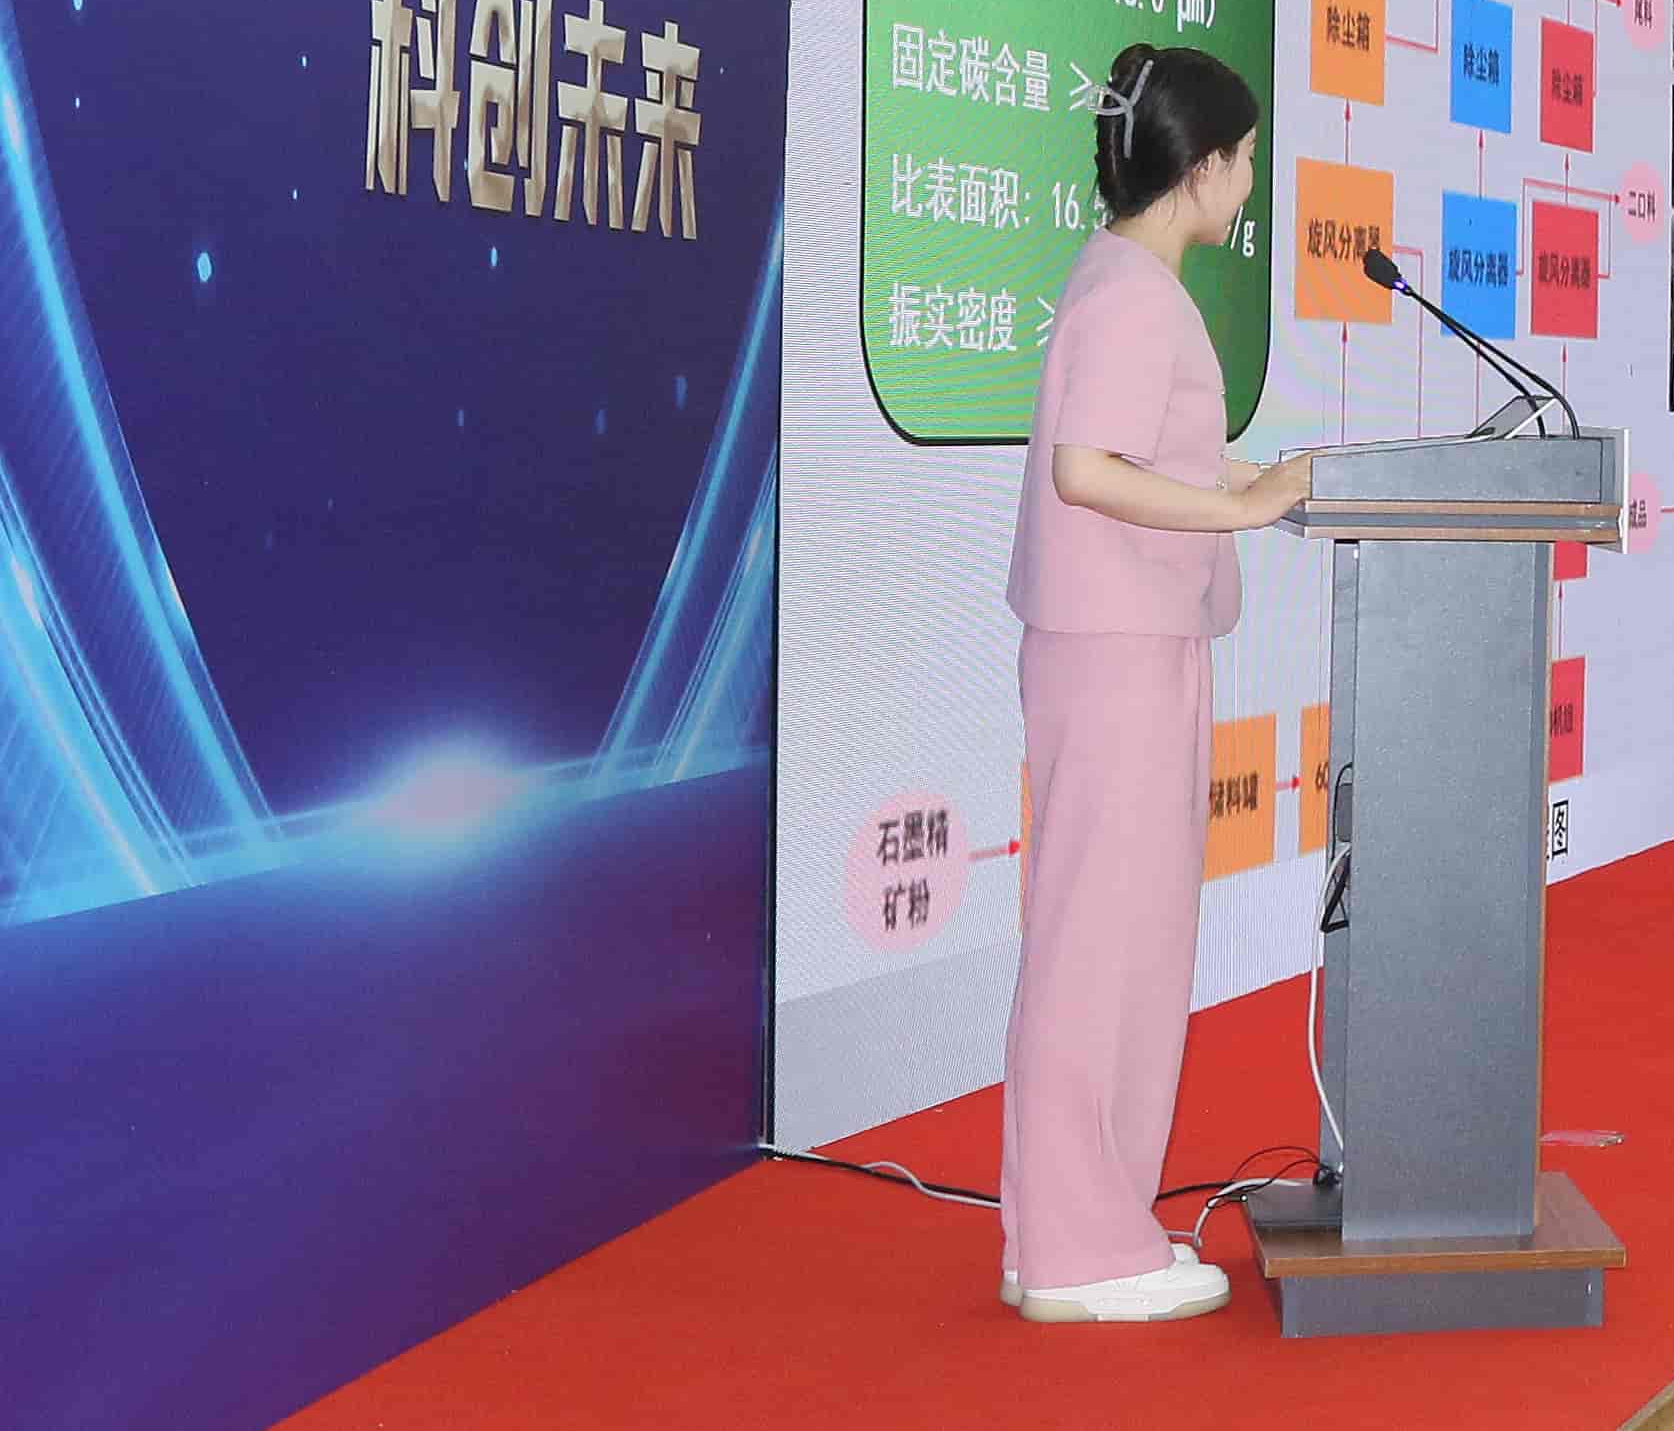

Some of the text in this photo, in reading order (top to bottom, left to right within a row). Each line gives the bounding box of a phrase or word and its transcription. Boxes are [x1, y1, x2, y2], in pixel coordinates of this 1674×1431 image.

[1326, 3, 1370, 52] 除尘箱
[891, 23, 1052, 113] 固定碳含量
[888, 283, 1018, 353] 振实密度
